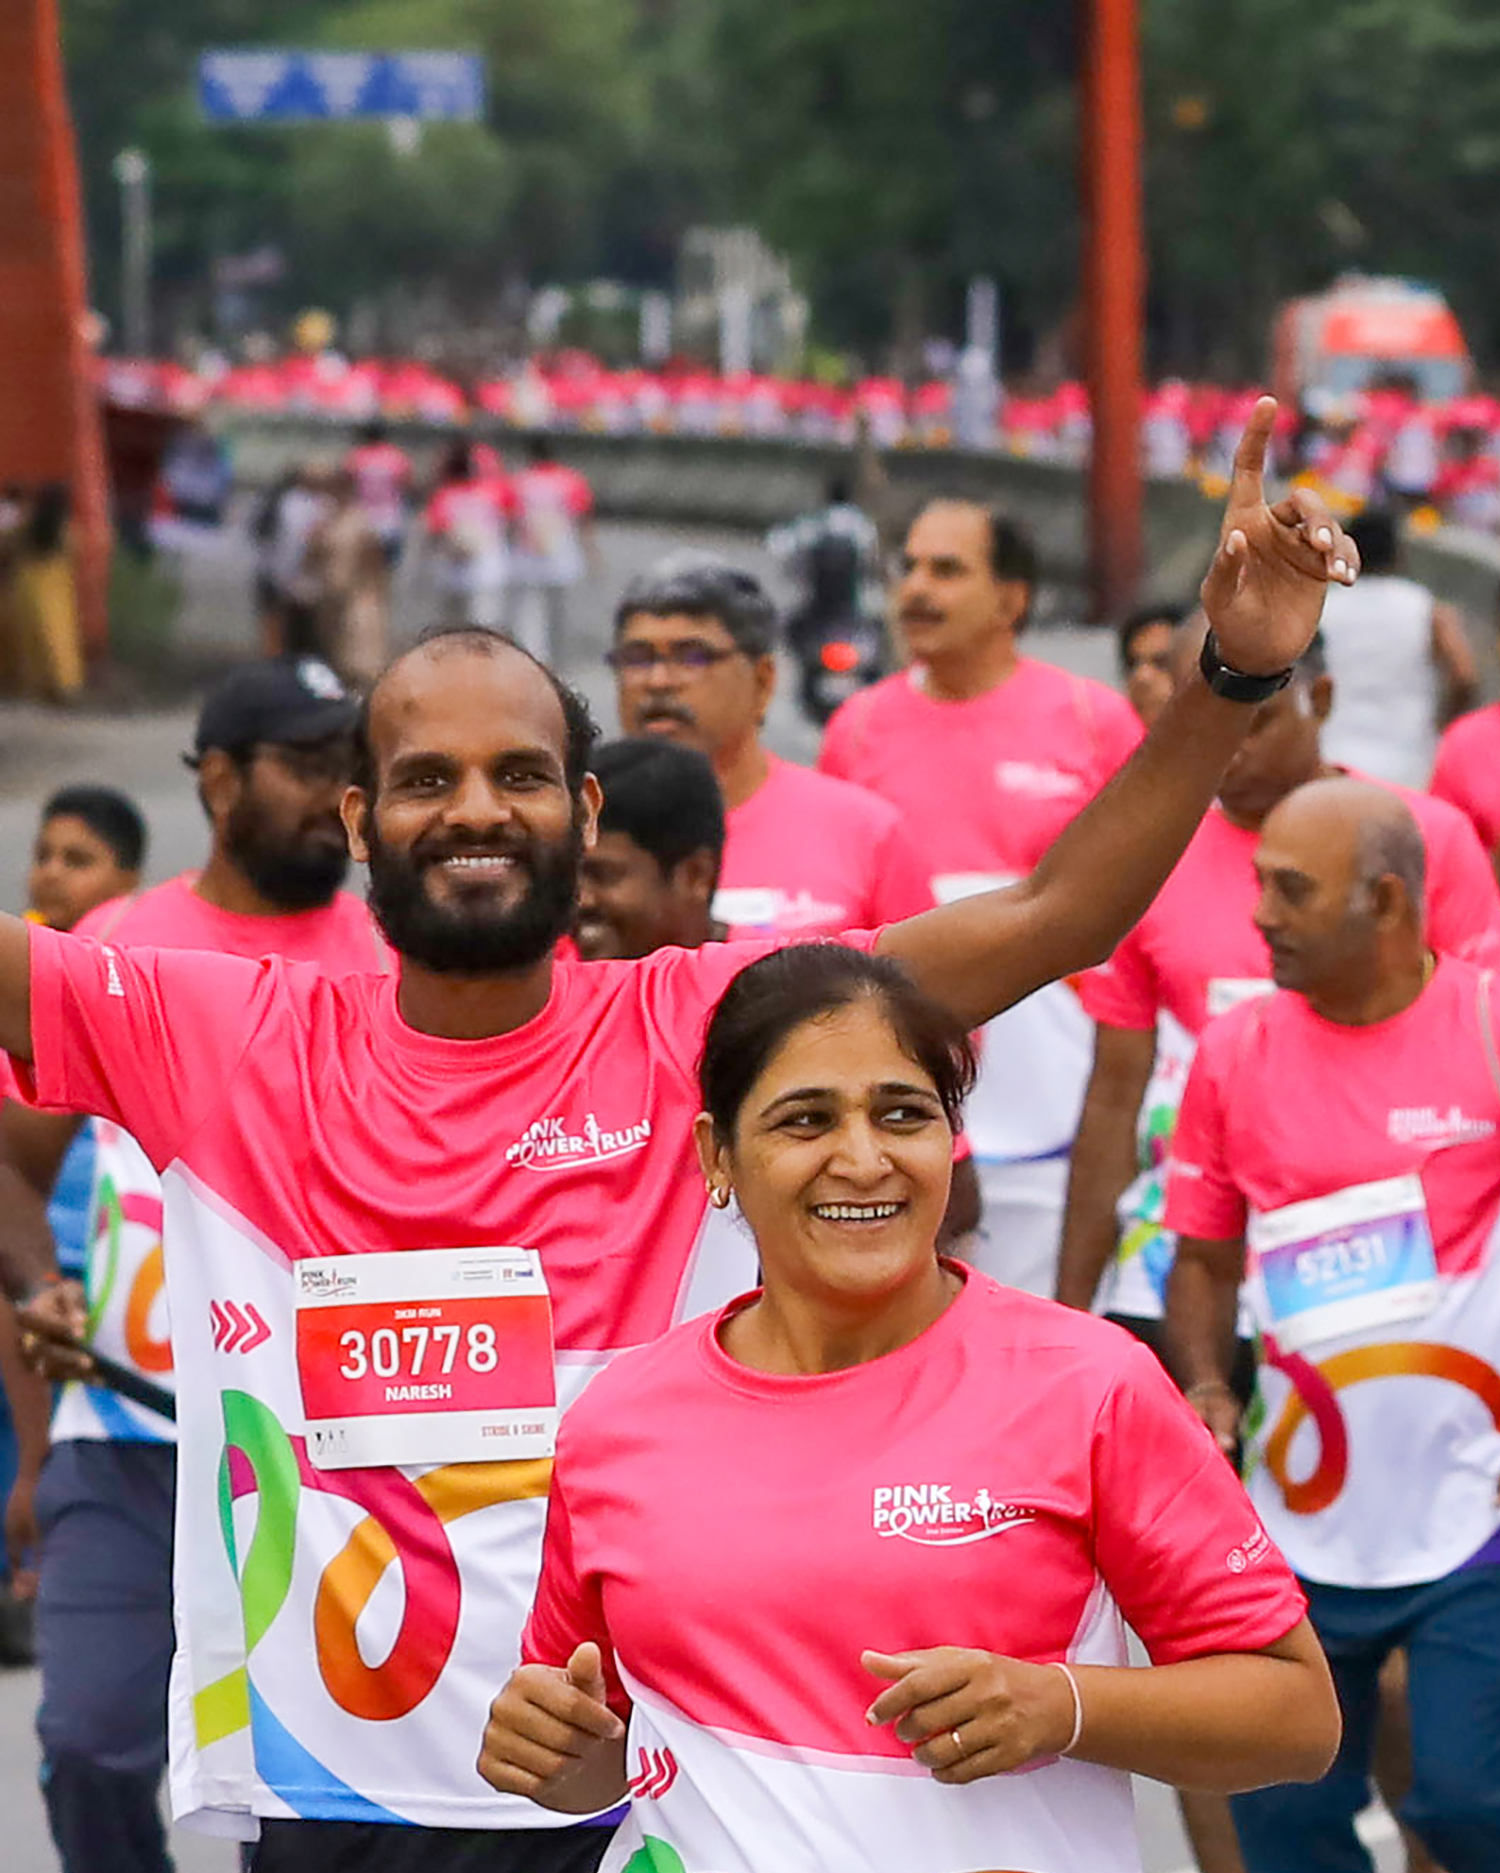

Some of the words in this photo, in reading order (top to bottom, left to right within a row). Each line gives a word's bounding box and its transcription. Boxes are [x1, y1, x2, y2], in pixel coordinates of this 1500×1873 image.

[601, 1118, 652, 1151] RUN
[1296, 1233, 1386, 1286] 52131
[339, 1324, 499, 1380] 30778
[385, 1384, 452, 1402] NARESH
[873, 1484, 952, 1509] PINK
[873, 1502, 973, 1531] POWER
